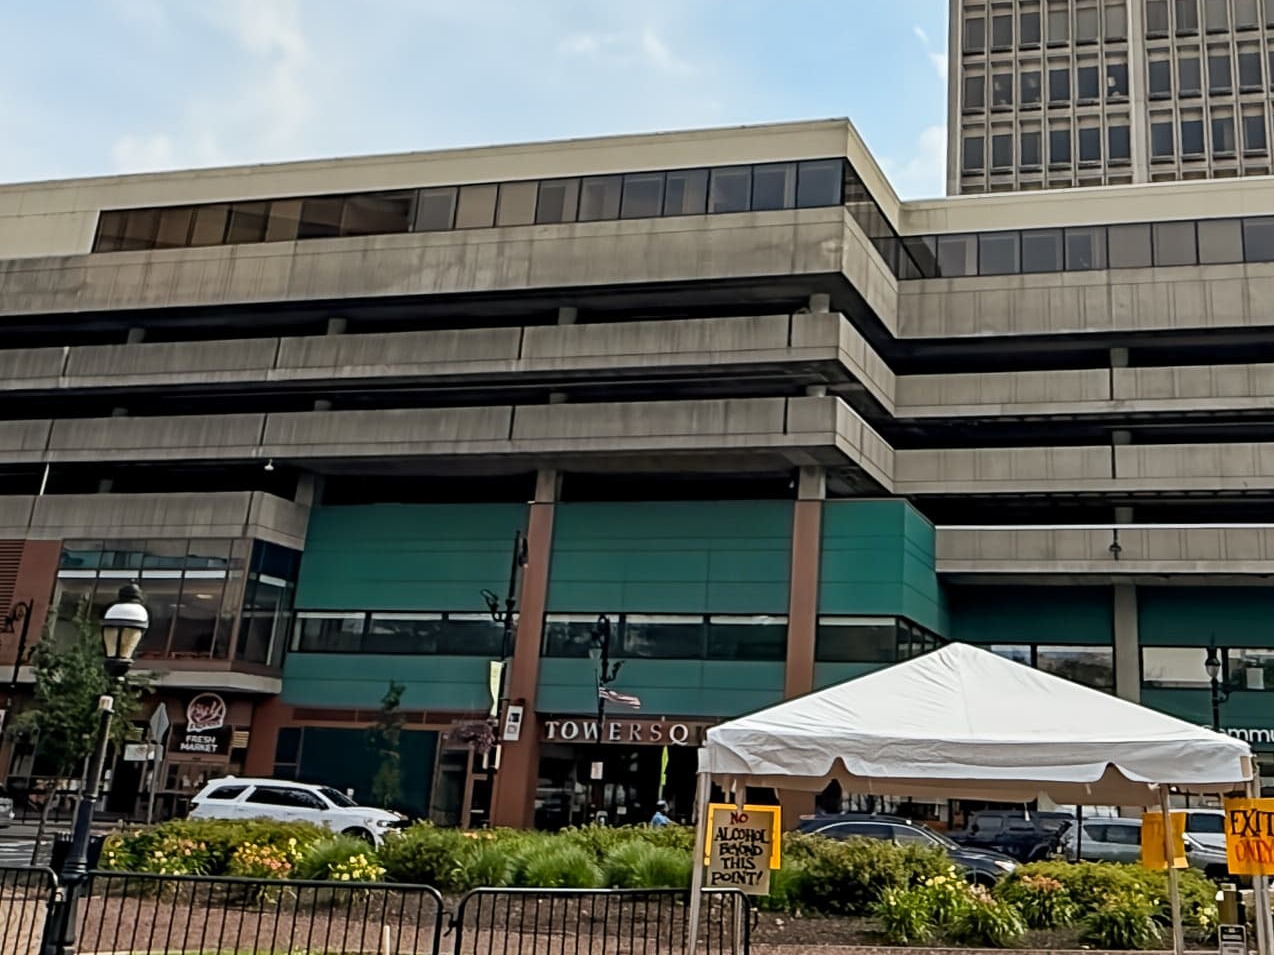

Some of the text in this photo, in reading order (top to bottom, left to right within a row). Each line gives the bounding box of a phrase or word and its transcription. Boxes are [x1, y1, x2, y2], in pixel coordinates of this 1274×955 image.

[185, 735, 217, 744] FRESH
[180, 742, 218, 753] MARKET
[730, 811, 749, 825] NO
[714, 827, 770, 844] ALCOHOL
[719, 842, 763, 857] BEYOND
[720, 857, 756, 870] THIS
[711, 871, 764, 885] POINT!
